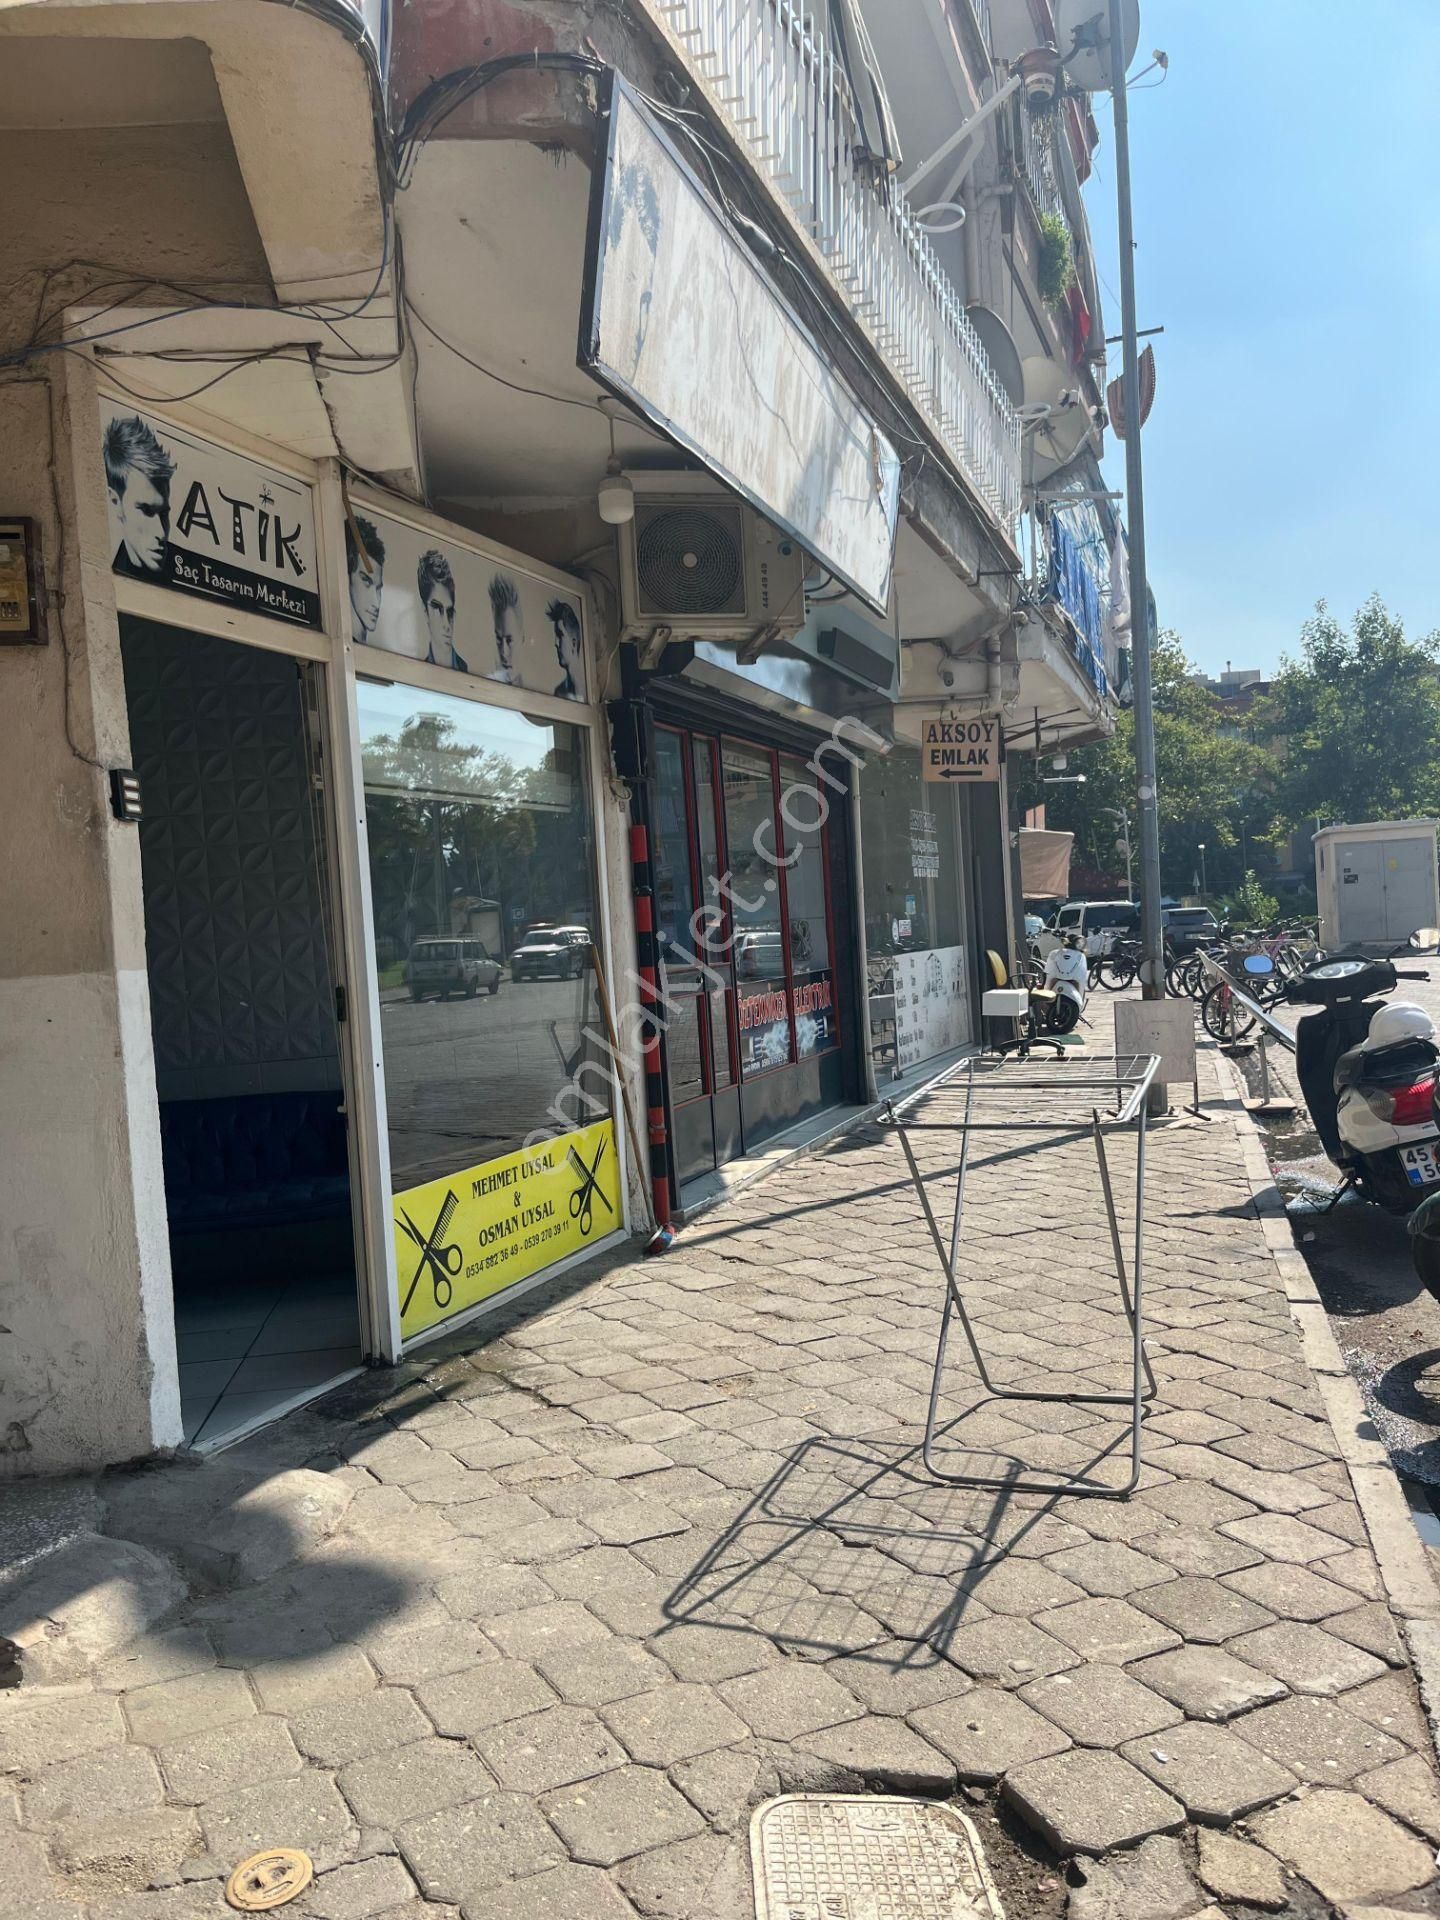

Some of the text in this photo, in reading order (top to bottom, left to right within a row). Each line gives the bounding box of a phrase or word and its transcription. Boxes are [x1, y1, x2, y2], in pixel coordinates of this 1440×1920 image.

[176, 482, 306, 576] ATİK
[174, 555, 306, 615] Saç Tasarım Merkezi
[927, 723, 995, 743] AKSOY
[931, 748, 989, 766] EMLAK
[472, 1153, 555, 1199] MEHMET UYSAL
[1406, 1147, 1429, 1164] 45
[513, 1191, 521, 1208] &
[479, 1200, 555, 1247] OSMAN UYSAL
[466, 1259, 484, 1278] 0534
[510, 1243, 519, 1256] 49
[524, 1233, 540, 1250] 0539
[553, 1223, 561, 1236] 39
[563, 1219, 570, 1231] 11
